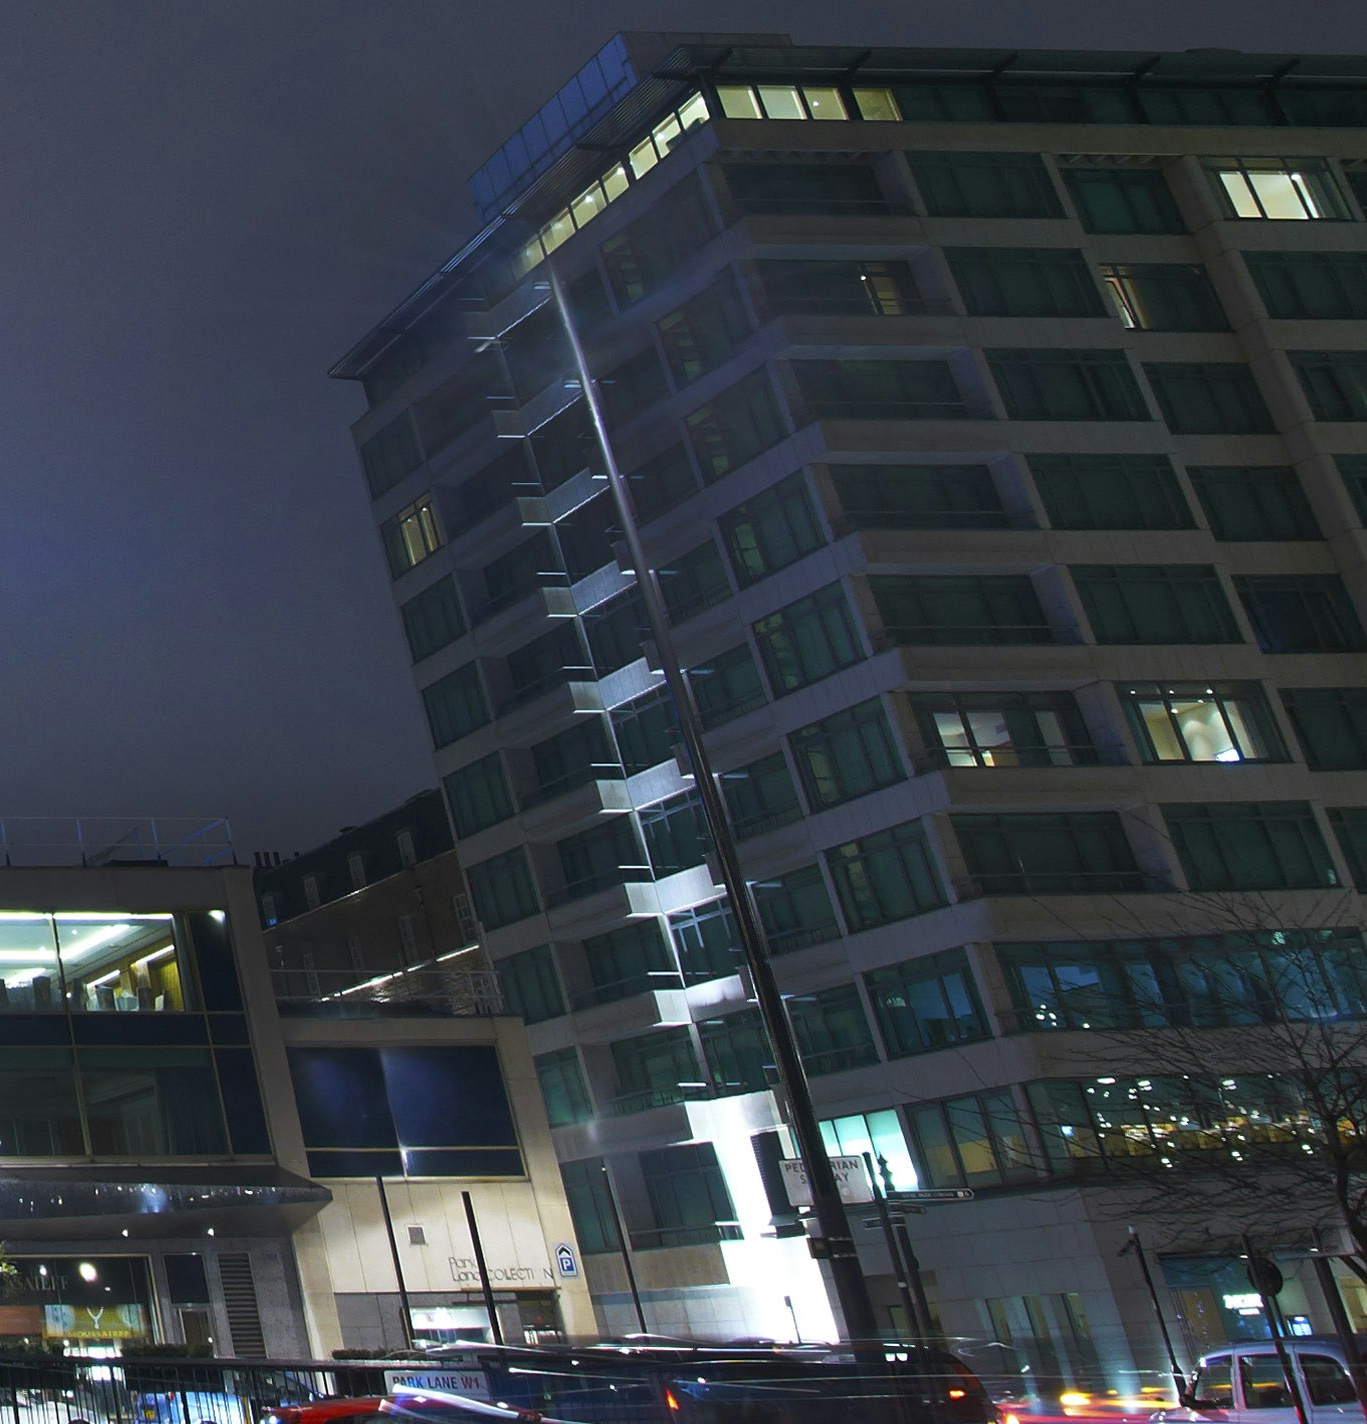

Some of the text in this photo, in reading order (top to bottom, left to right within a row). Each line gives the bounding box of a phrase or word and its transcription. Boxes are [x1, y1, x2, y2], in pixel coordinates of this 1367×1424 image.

[800, 1172, 848, 1184] SAY
[392, 1376, 480, 1390] PARK LANE W1
